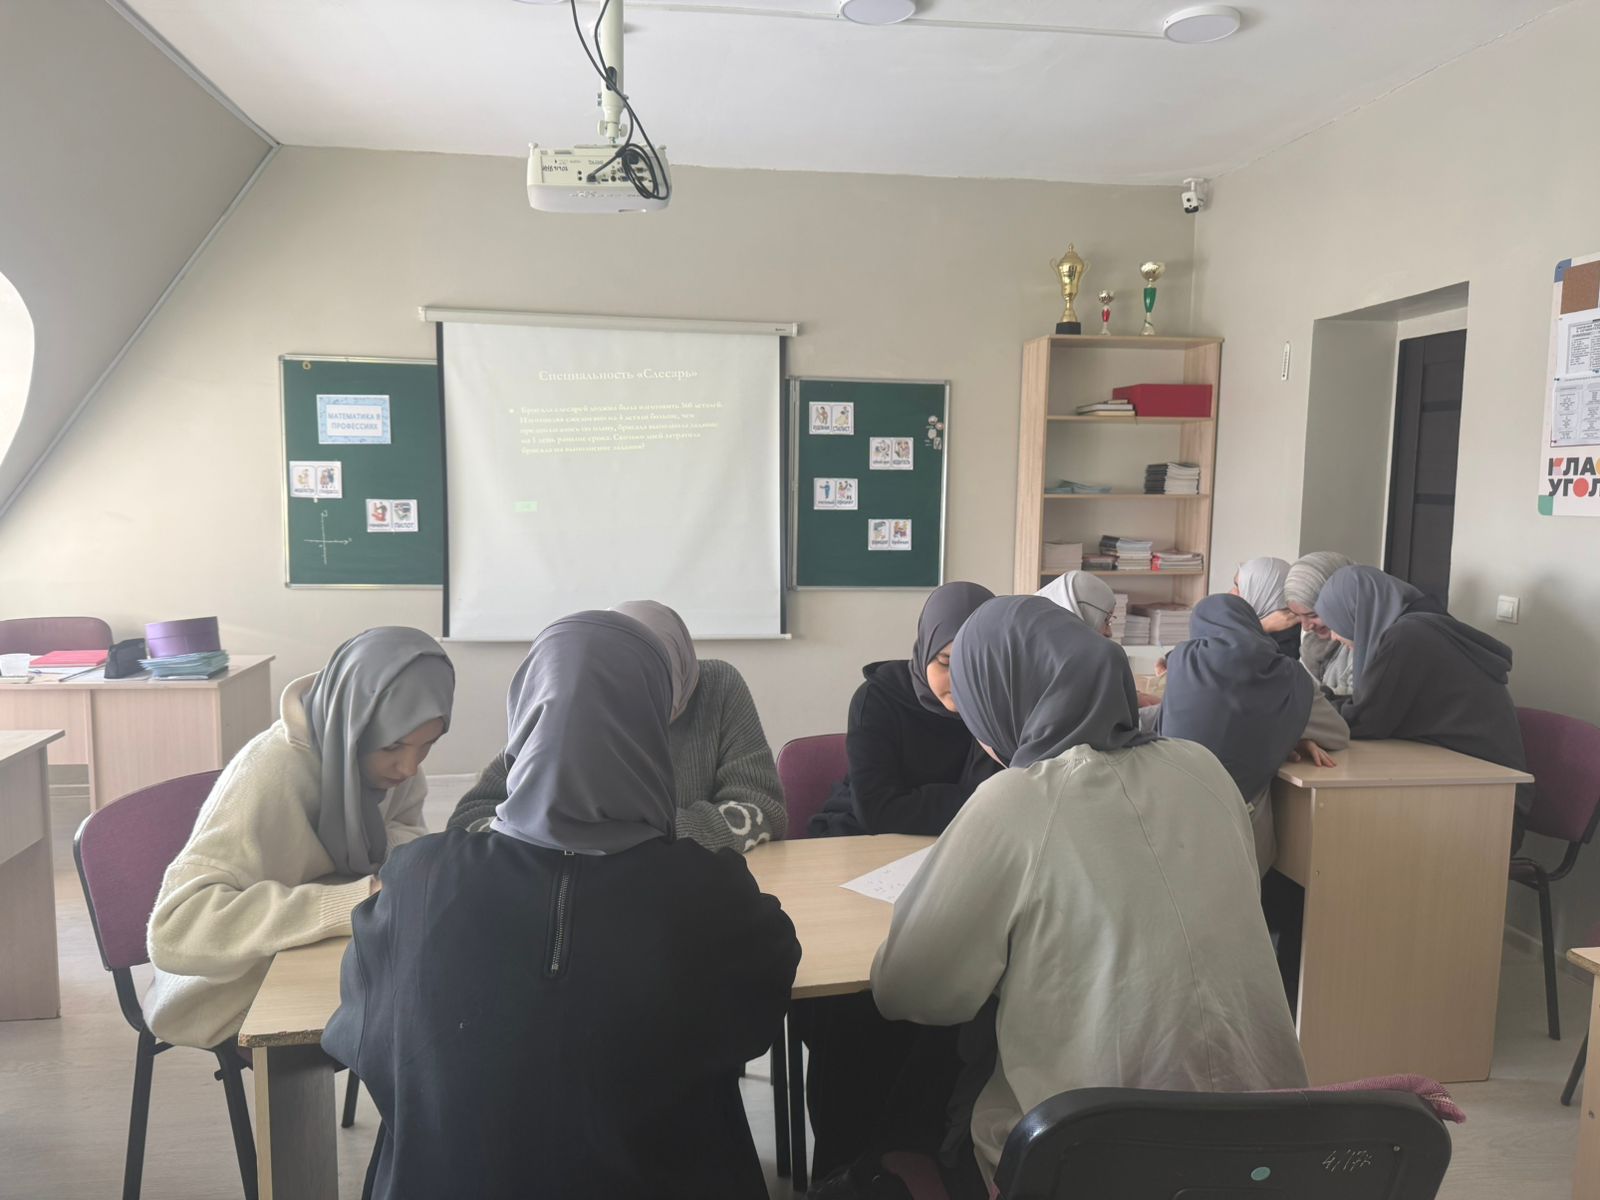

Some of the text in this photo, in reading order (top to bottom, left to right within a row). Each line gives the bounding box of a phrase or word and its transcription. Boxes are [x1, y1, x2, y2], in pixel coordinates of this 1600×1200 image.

[538, 368, 698, 381] Специальность «Слесарь»
[328, 412, 375, 420] МАТЕМАТИКА
[331, 422, 378, 430] ПРОФЕССИЯХ
[1548, 456, 1600, 476] КЛА
